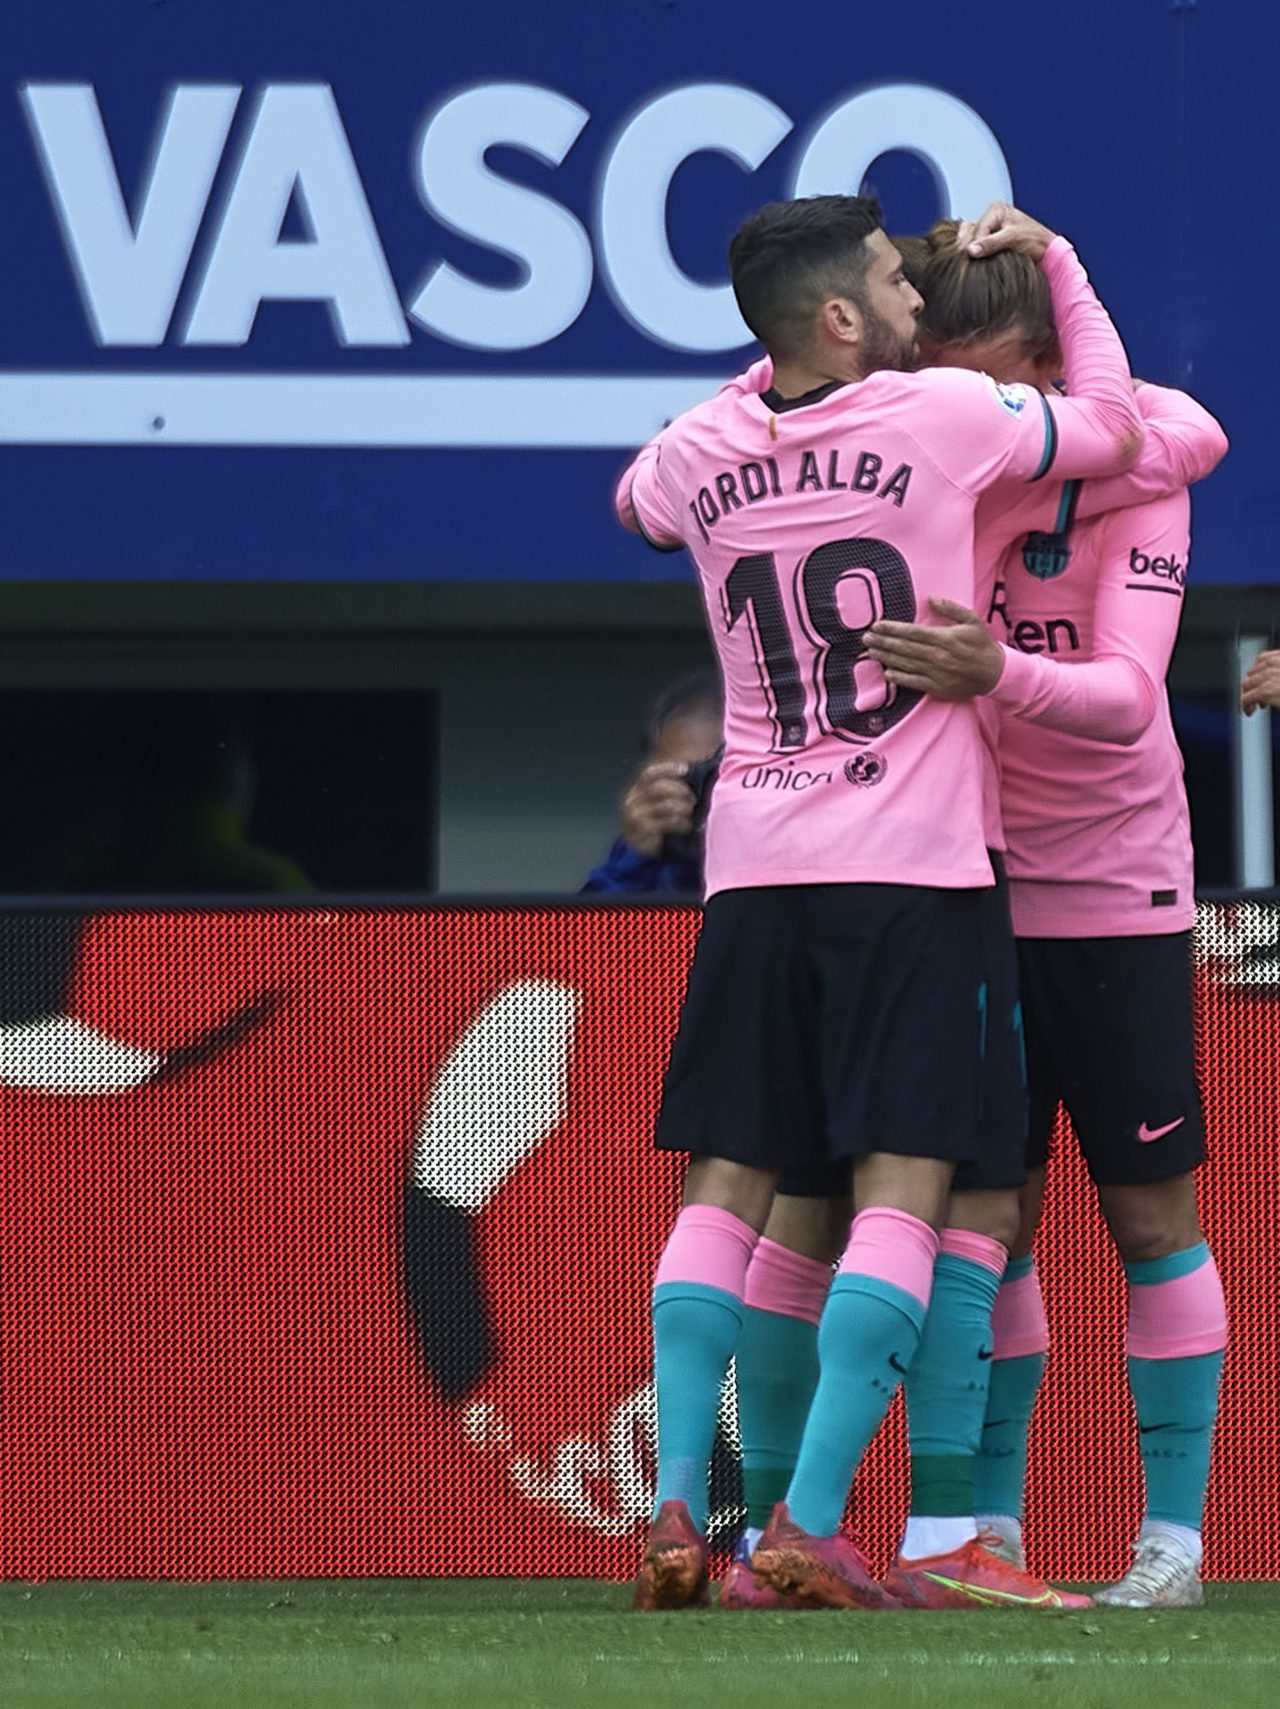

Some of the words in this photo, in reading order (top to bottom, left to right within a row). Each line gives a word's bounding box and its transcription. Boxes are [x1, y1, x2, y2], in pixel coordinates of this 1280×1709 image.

[690, 457, 783, 546] JORDI
[796, 449, 913, 508] ALBA
[722, 537, 922, 754] 18
